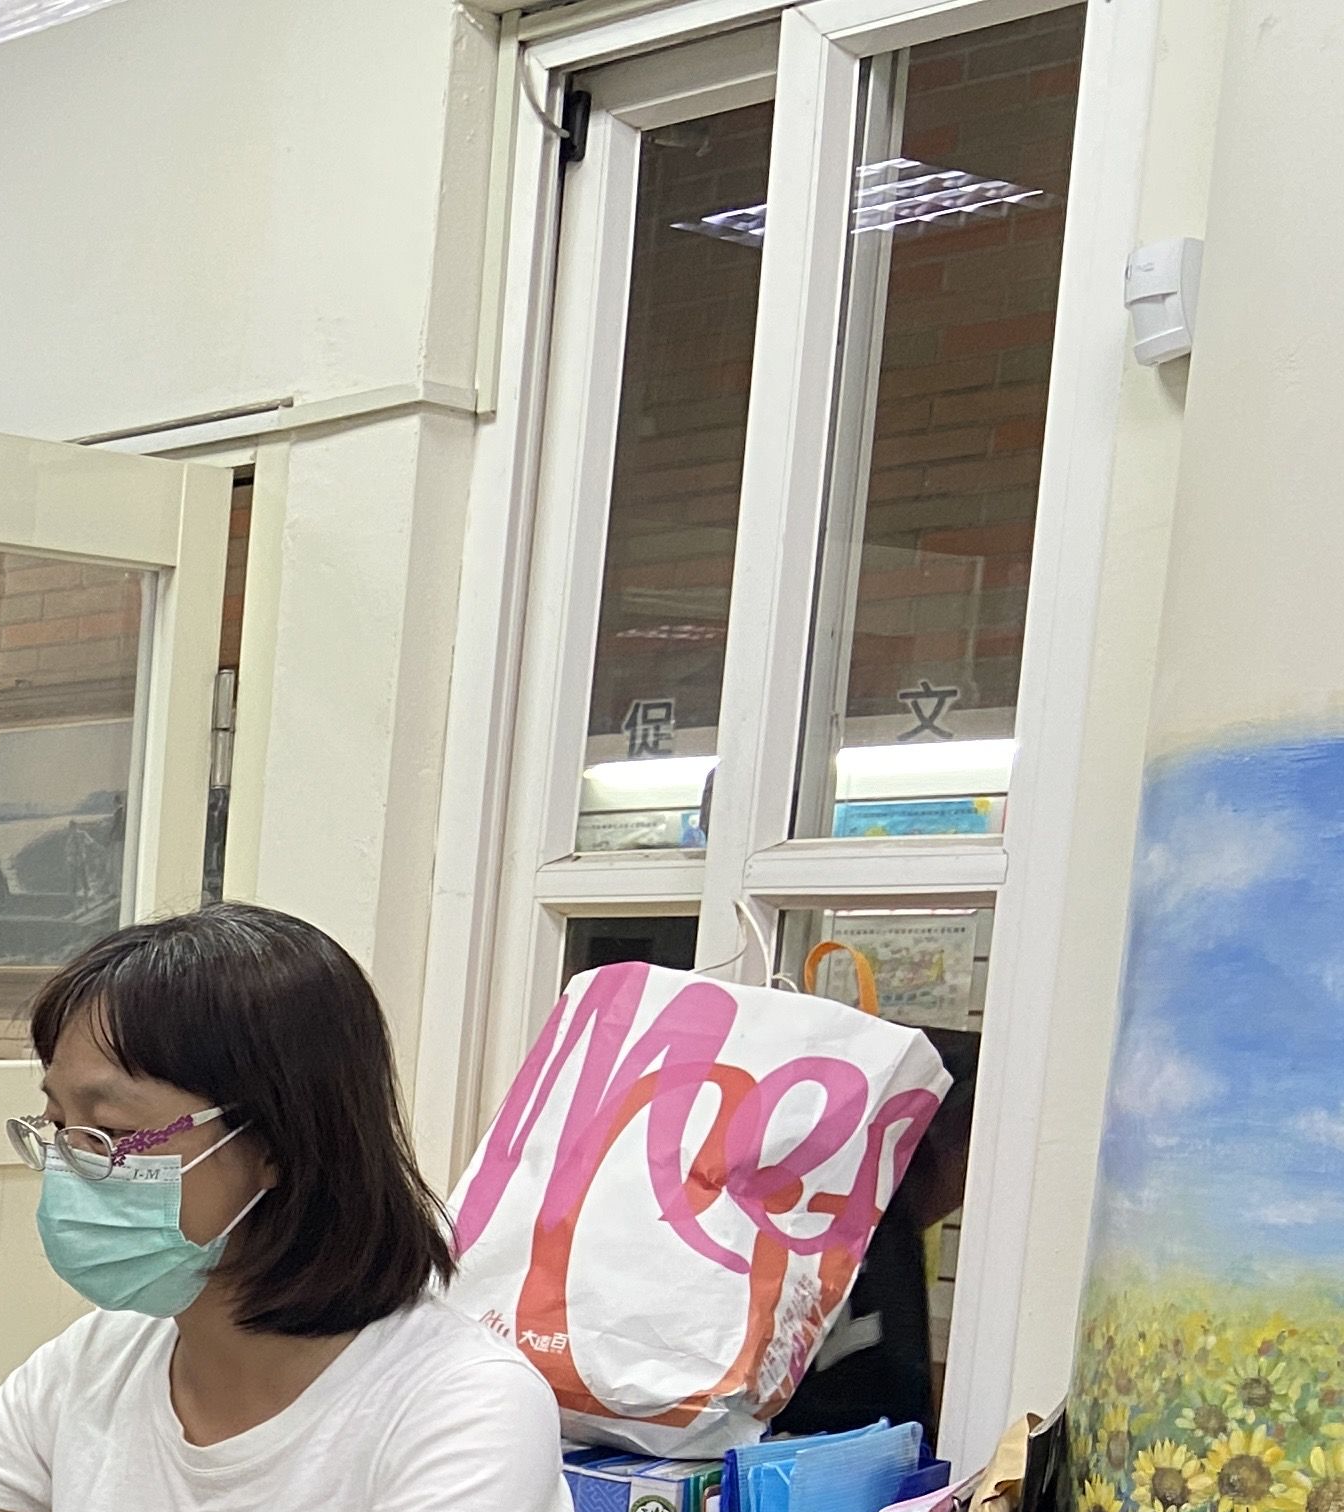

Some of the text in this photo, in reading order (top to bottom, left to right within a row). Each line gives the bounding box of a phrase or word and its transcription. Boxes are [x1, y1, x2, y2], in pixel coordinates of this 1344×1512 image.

[897, 680, 959, 742] 文
[519, 1330, 569, 1352] 大遠百
